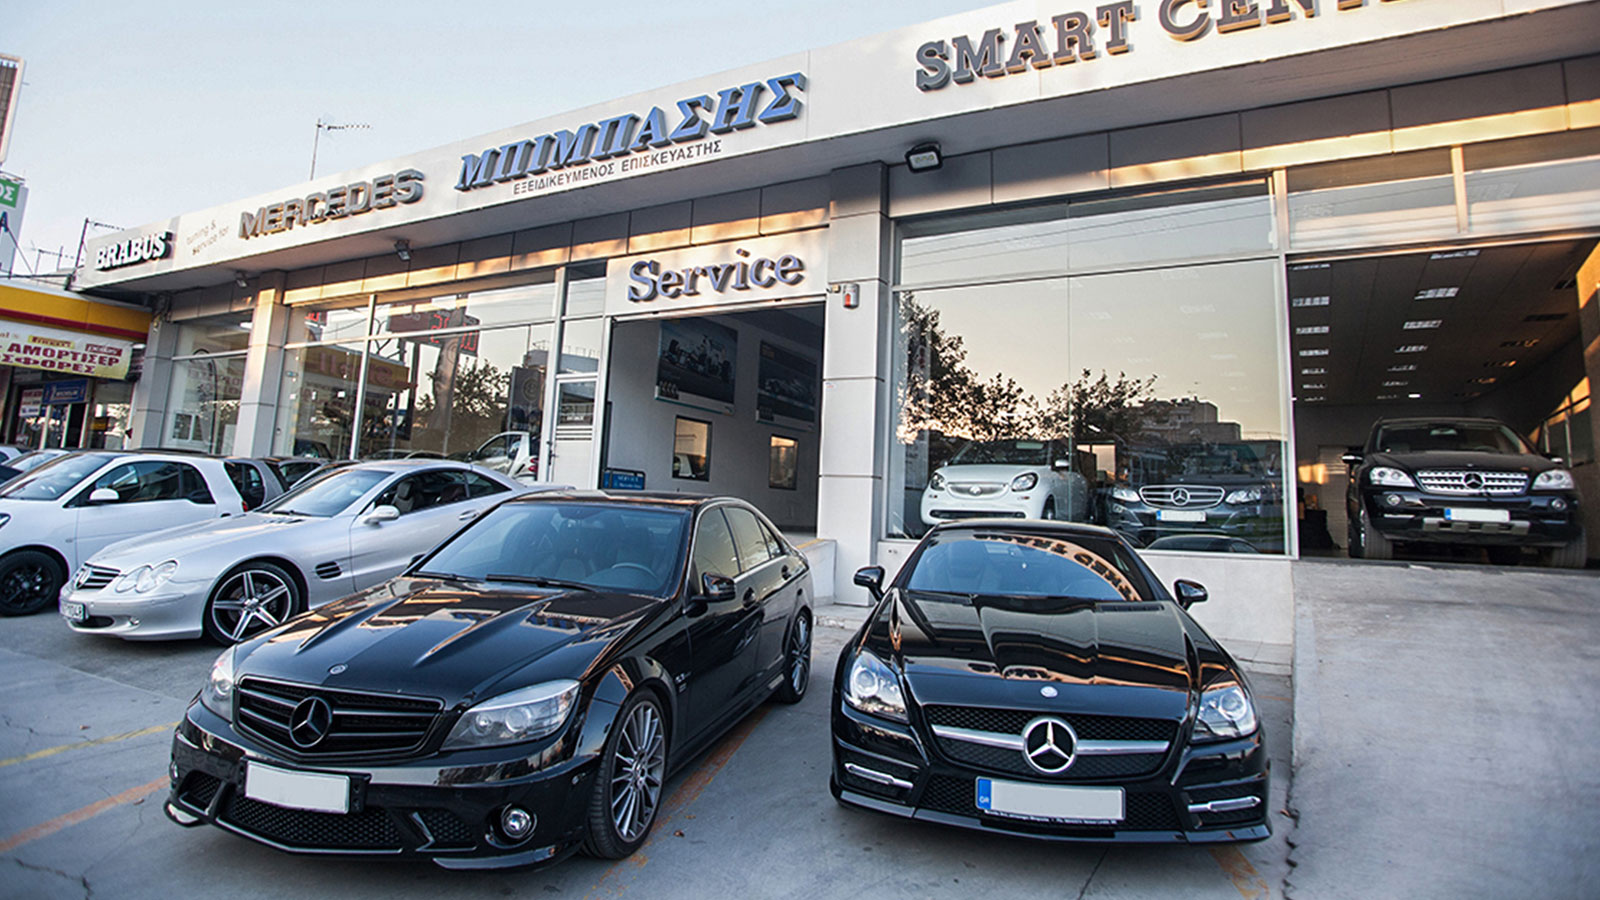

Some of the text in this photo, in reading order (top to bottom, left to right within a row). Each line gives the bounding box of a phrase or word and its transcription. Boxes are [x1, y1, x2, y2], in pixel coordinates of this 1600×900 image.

[915, 0, 1140, 93] SMART
[454, 72, 806, 192] ΜΠΙΜΠΑΣΗΣ
[513, 139, 722, 195] ΕΞΕΙΔΙΚΕΥΜΕΝΟΣ ΕΠΙΣΚΕΥΑΣΤΗΣ
[239, 168, 425, 240] MERCEDES
[95, 231, 173, 270] BRABUS
[628, 247, 805, 303] Service
[0, 353, 96, 374] ΣΦΟΡΕΣ
[8, 342, 120, 367] ΑΜΟΡΤΙΣΕΡ
